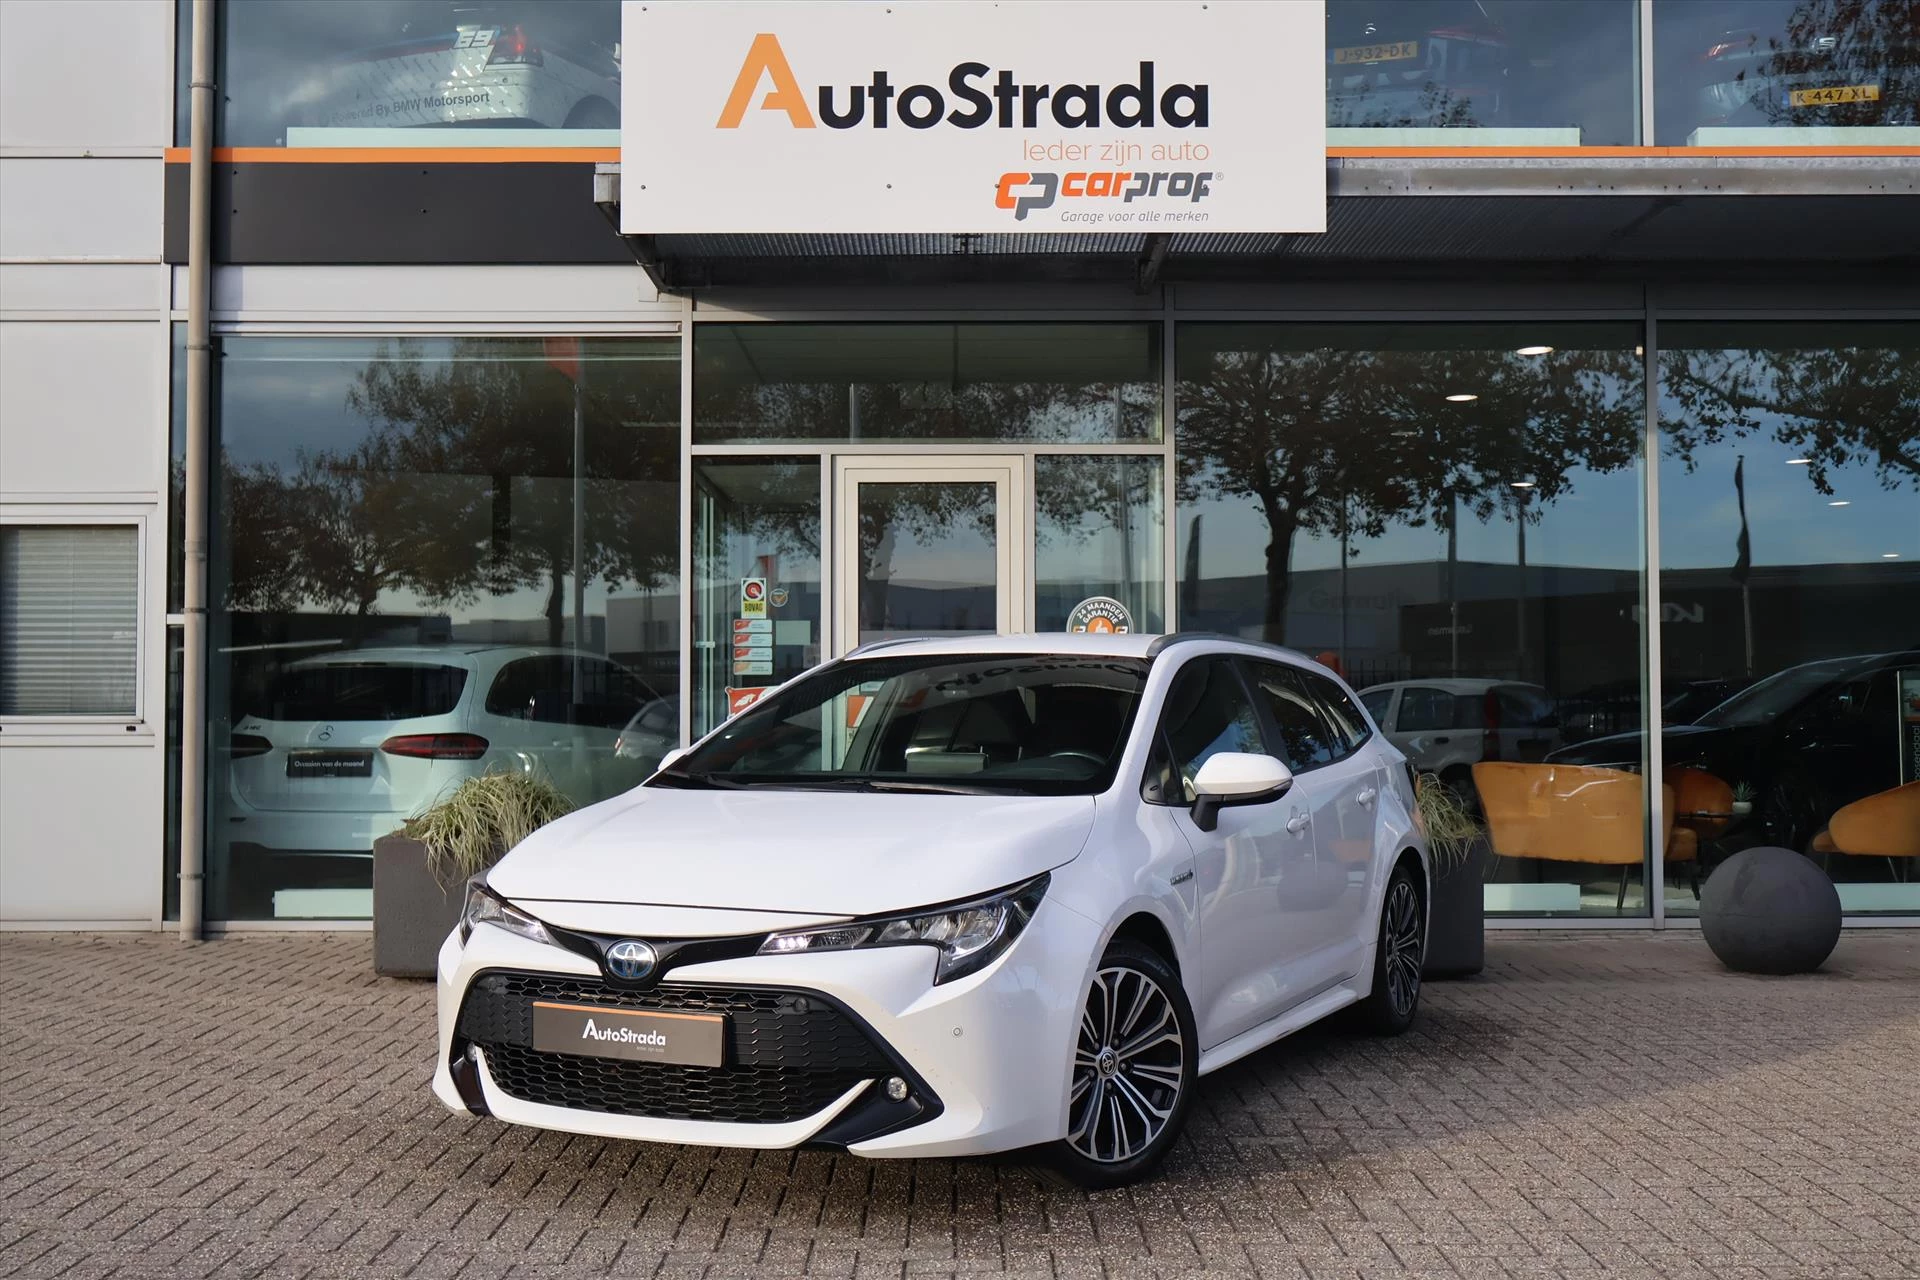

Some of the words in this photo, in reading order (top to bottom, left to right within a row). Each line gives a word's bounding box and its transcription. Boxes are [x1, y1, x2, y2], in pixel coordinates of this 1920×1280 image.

[453, 30, 495, 49] 69
[1341, 43, 1411, 62] J-932-DK
[715, 33, 1209, 130] AutoStrada
[375, 103, 390, 118] By
[393, 99, 421, 113] BMW
[424, 91, 490, 109] Motorsport
[1796, 87, 1872, 104] K-447-XL
[1023, 139, 1093, 161] Ieder
[1100, 139, 1143, 167] zijn
[1150, 140, 1210, 161] auto
[1060, 211, 1104, 224] Garage
[1108, 213, 1135, 222] voor
[1138, 211, 1161, 222] alle
[1164, 211, 1209, 222] merken
[744, 602, 763, 612] BOVAG
[1082, 609, 1120, 624] GARANTIE
[1086, 602, 1125, 620] MAANDEN
[582, 1018, 666, 1046] AutoStrada
